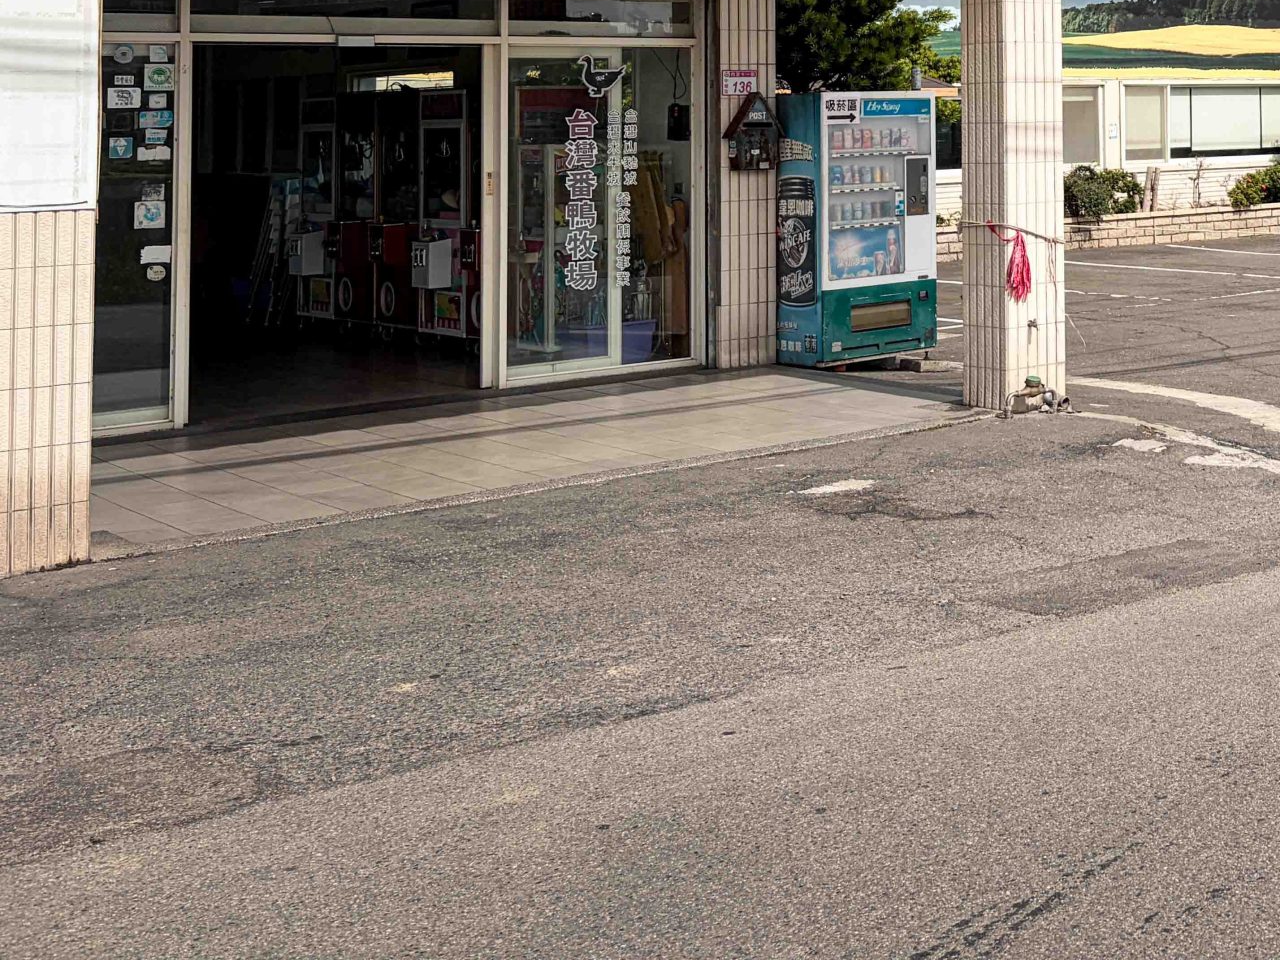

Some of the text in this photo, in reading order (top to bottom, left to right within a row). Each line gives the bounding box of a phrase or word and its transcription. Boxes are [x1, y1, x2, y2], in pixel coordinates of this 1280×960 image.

[732, 80, 753, 94] 136
[825, 99, 858, 112] 吸菸區
[749, 111, 767, 121] POST
[564, 108, 598, 291] 台灣番鴨牧場
[615, 191, 632, 287] 餐飲關係事業
